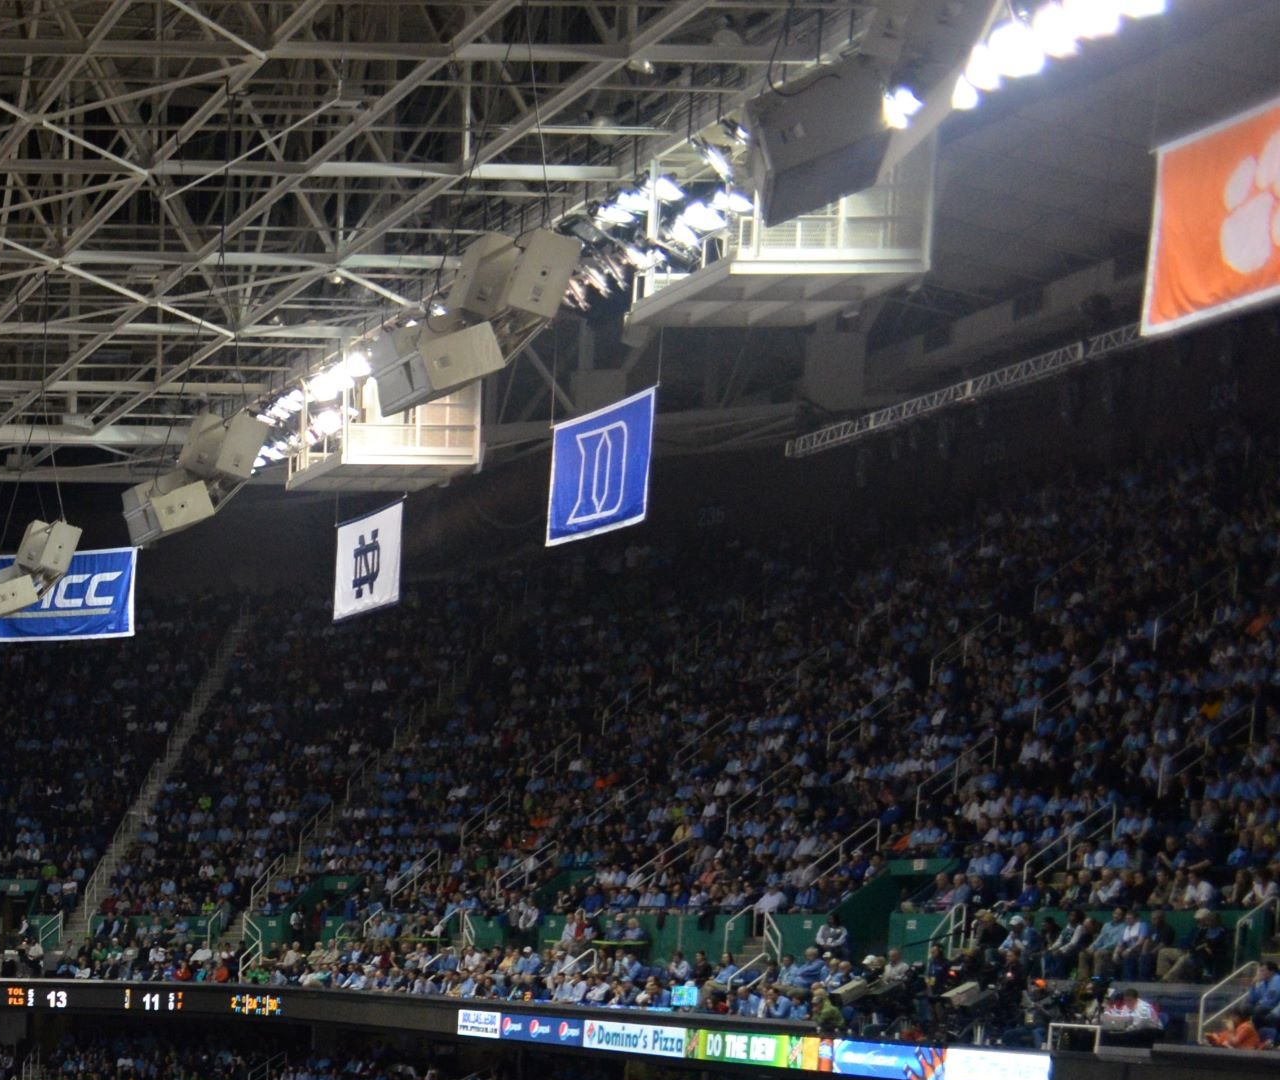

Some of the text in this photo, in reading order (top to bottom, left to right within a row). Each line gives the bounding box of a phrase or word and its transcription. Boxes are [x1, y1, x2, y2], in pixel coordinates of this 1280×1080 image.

[7, 988, 25, 996] TOL
[46, 990, 68, 1008] 13
[142, 993, 160, 1011] 11
[597, 1025, 684, 1053] Domino's Pizza
[725, 1035, 748, 1059] THE
